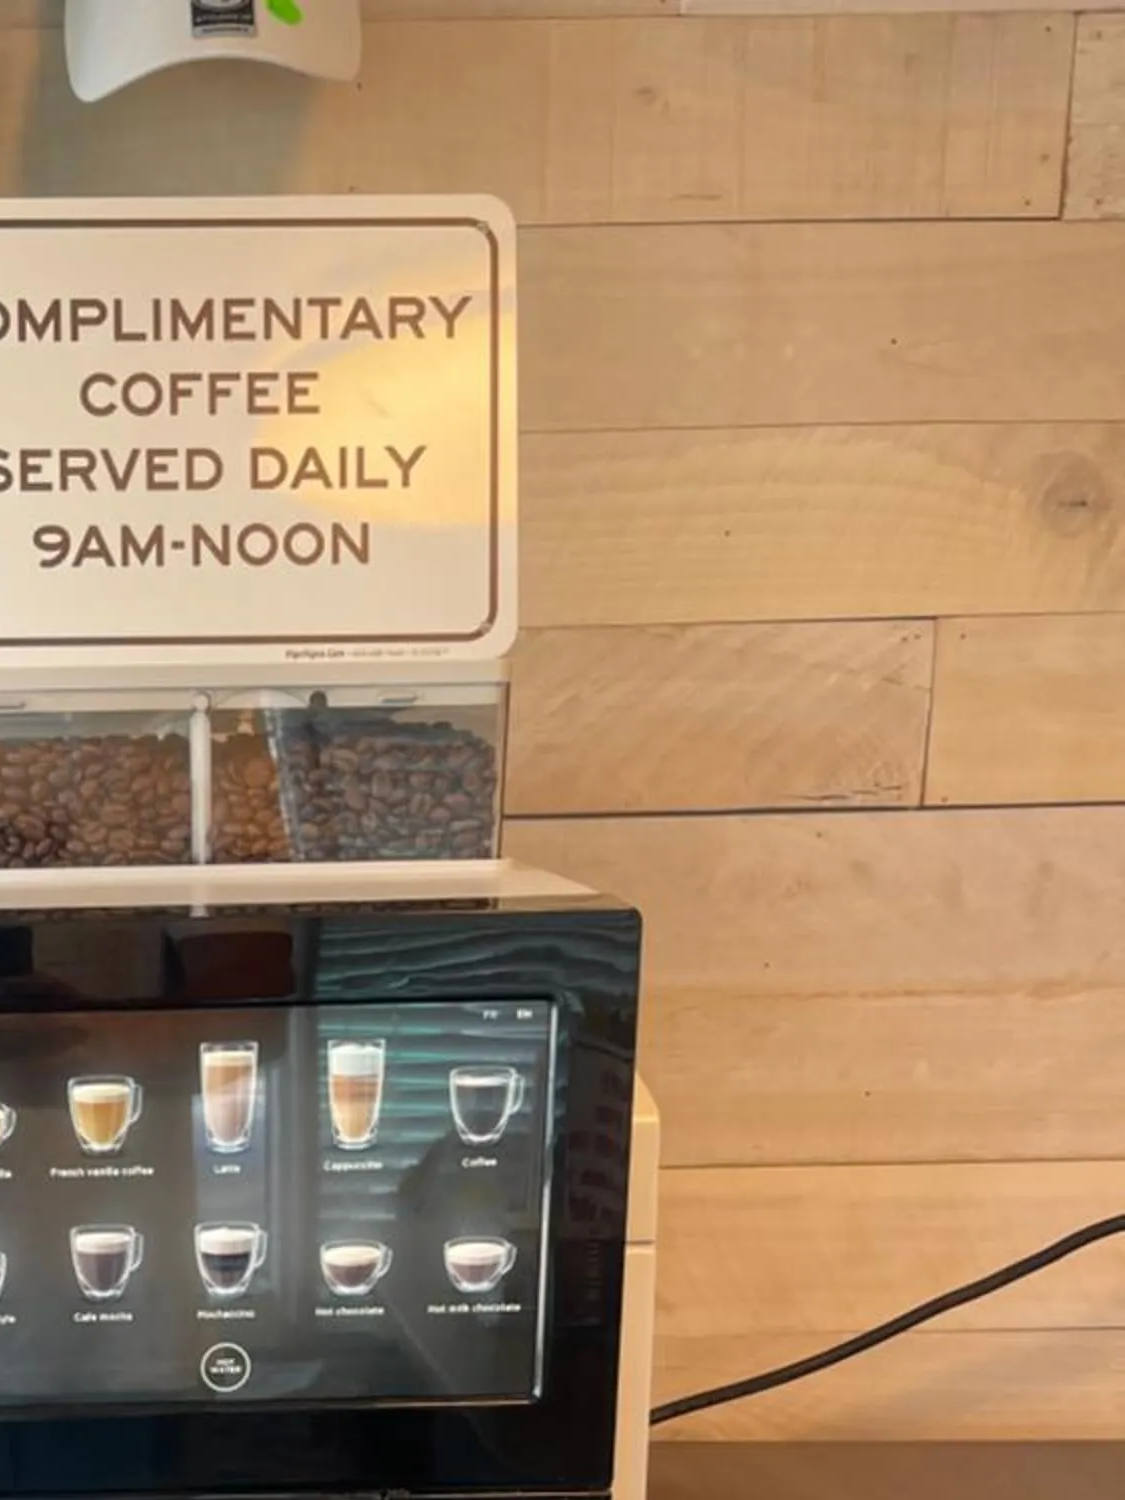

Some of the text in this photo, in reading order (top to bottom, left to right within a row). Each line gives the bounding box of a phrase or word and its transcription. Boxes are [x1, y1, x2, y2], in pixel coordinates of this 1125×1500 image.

[79, 372, 320, 417] COFFEE
[249, 445, 427, 490] DAILY
[32, 522, 370, 568] 9AM-NOON
[49, 1166, 85, 1179] French
[461, 1156, 498, 1169] Coffee
